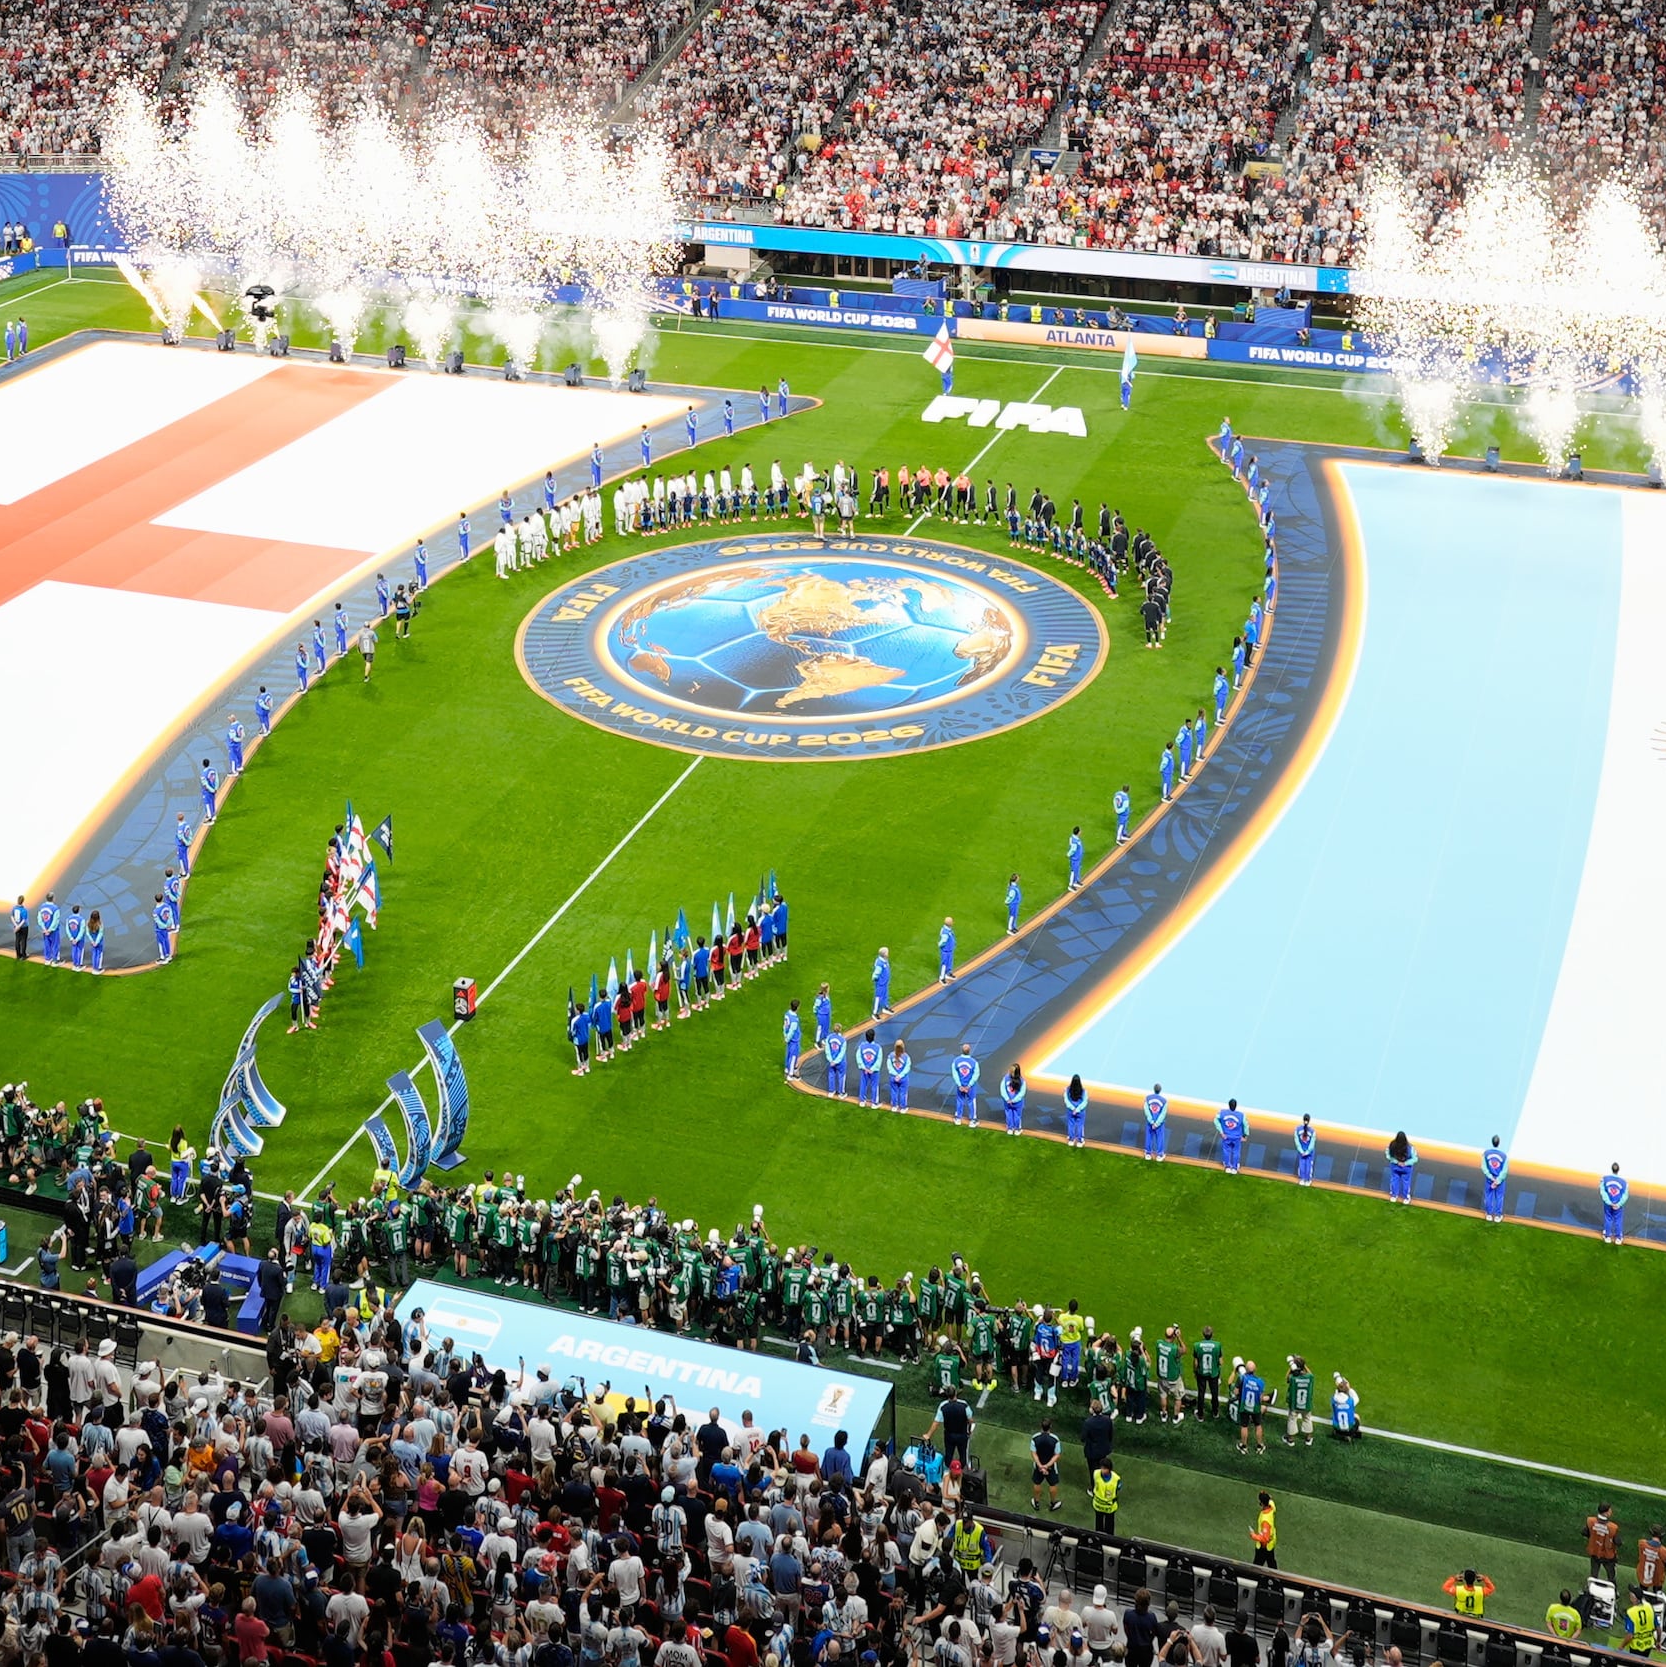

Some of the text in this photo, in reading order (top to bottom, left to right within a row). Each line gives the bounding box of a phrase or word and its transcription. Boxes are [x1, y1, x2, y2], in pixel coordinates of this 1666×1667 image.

[692, 225, 754, 244] ARGENTINA
[1238, 266, 1307, 286] ARGENTINA
[767, 306, 917, 330] FIFA WORLD CUP 2026
[1046, 329, 1116, 347] ATLANTA
[1249, 346, 1365, 367] FIFA WORLD CUP
[921, 395, 1088, 437] FIFA
[718, 541, 1039, 594] FIFA WORLD CUP 2026
[549, 582, 621, 623] FIFA
[1020, 643, 1082, 688] FIFA
[562, 677, 926, 747] FIFA WORLD CUP 2026
[546, 1334, 763, 1399] ARGENTINA
[10, 1502, 28, 1525] 10
[665, 1650, 689, 1662] MOM
